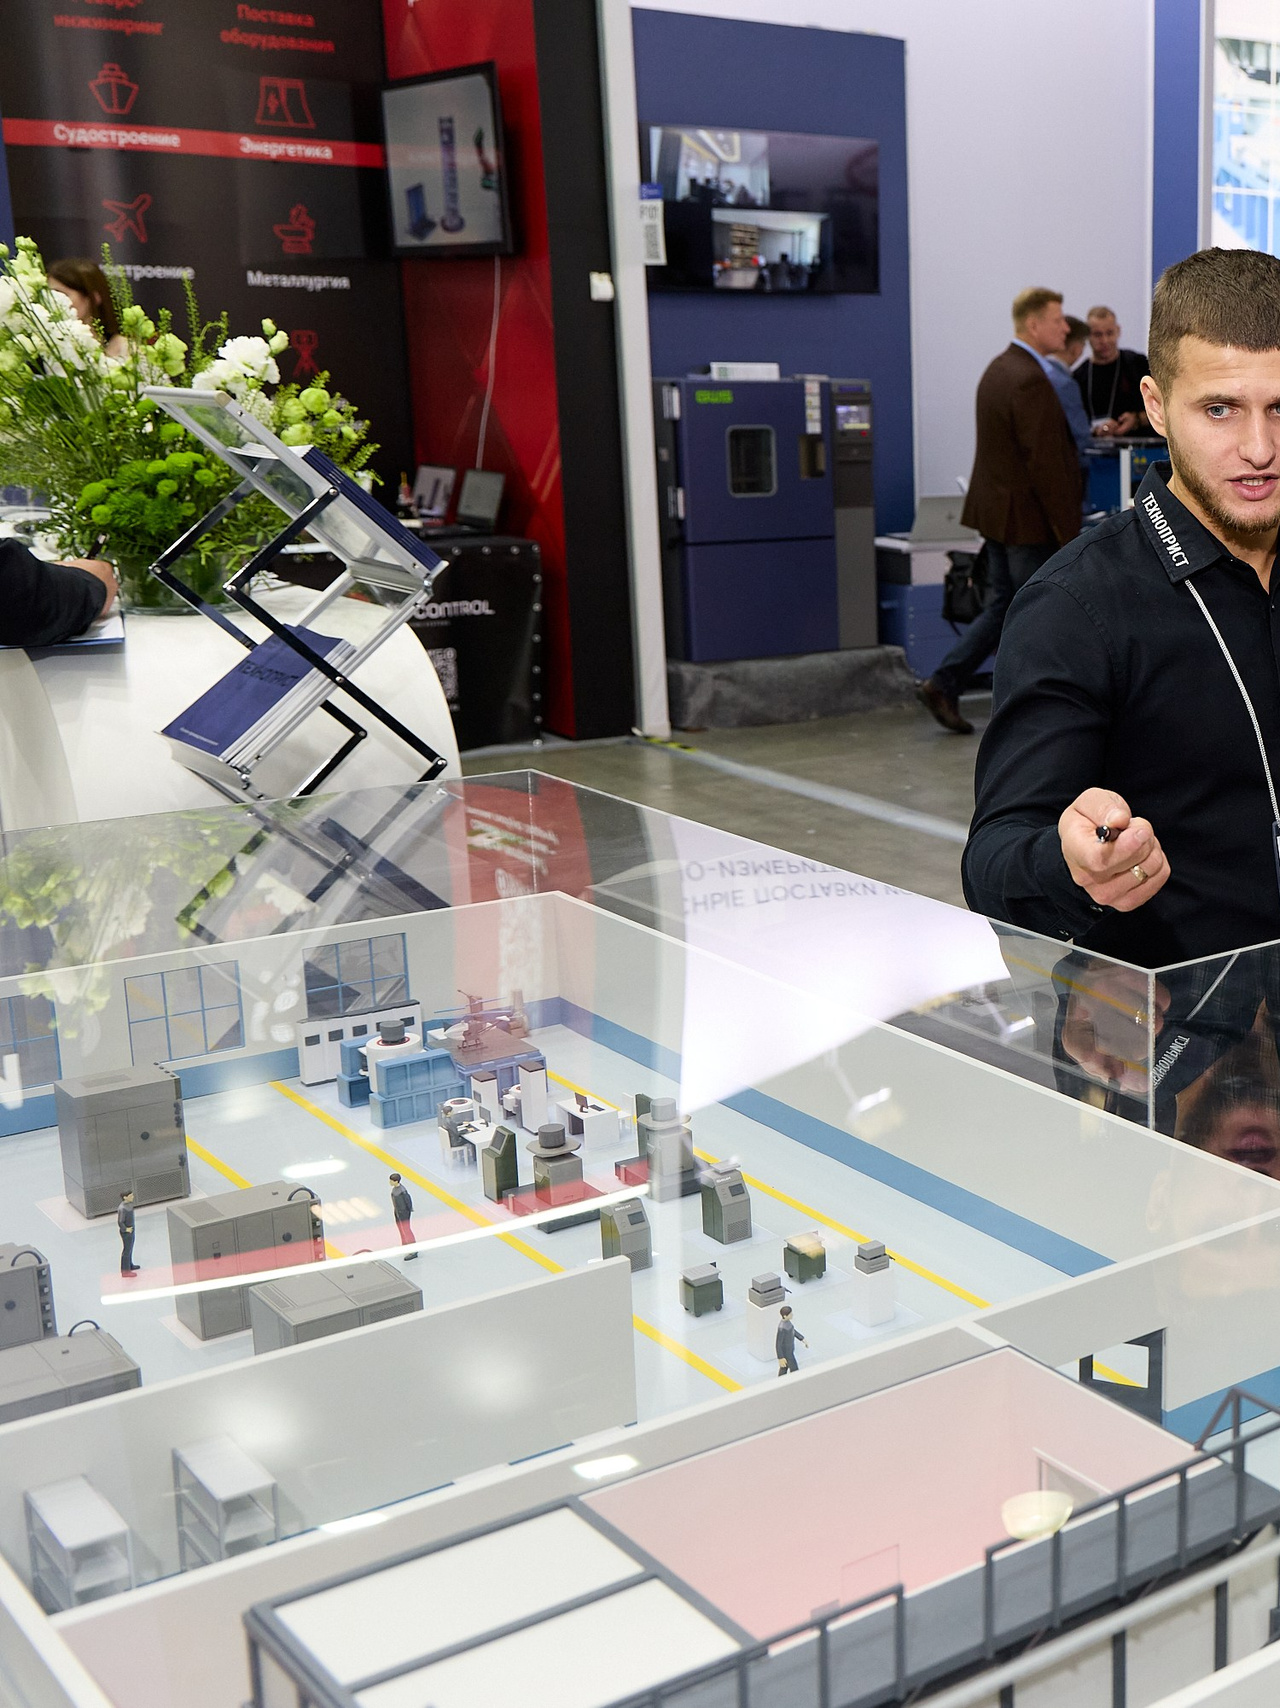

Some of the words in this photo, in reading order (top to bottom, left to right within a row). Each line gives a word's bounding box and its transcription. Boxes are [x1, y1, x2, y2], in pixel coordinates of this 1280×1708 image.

[53, 123, 181, 149] Судостроение
[239, 136, 333, 160] Энергетика
[246, 270, 351, 291] Металлургия
[1141, 491, 1191, 568] ТЕХНОПРИСТ
